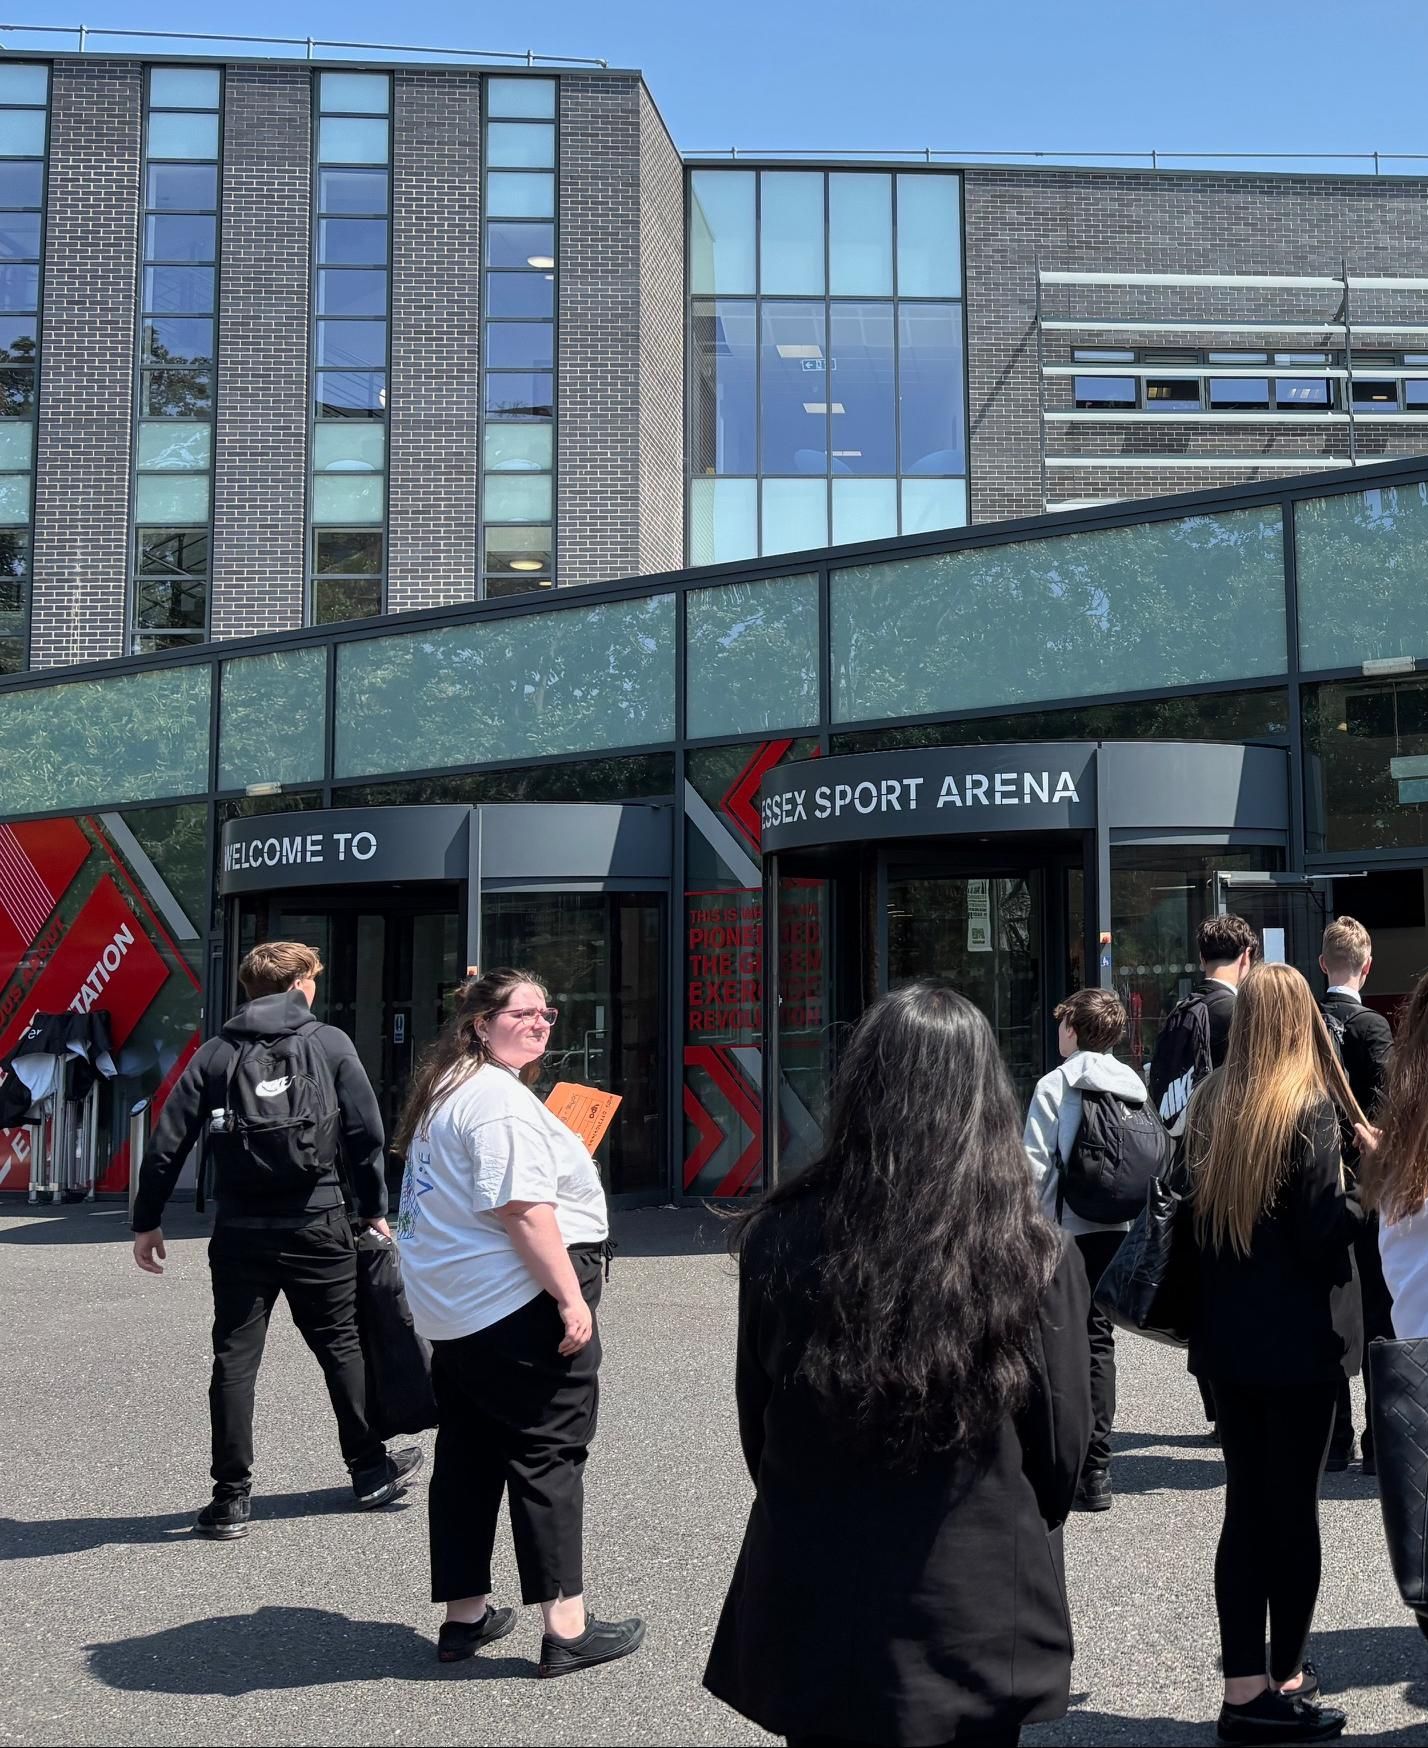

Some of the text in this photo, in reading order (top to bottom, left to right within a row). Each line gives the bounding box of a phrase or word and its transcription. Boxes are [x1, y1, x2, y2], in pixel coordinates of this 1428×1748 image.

[761, 771, 1080, 831] ESSEX SPORT ARENA
[224, 831, 377, 872] WELCOME TO
[724, 907, 737, 922] IS
[689, 952, 733, 977] THE
